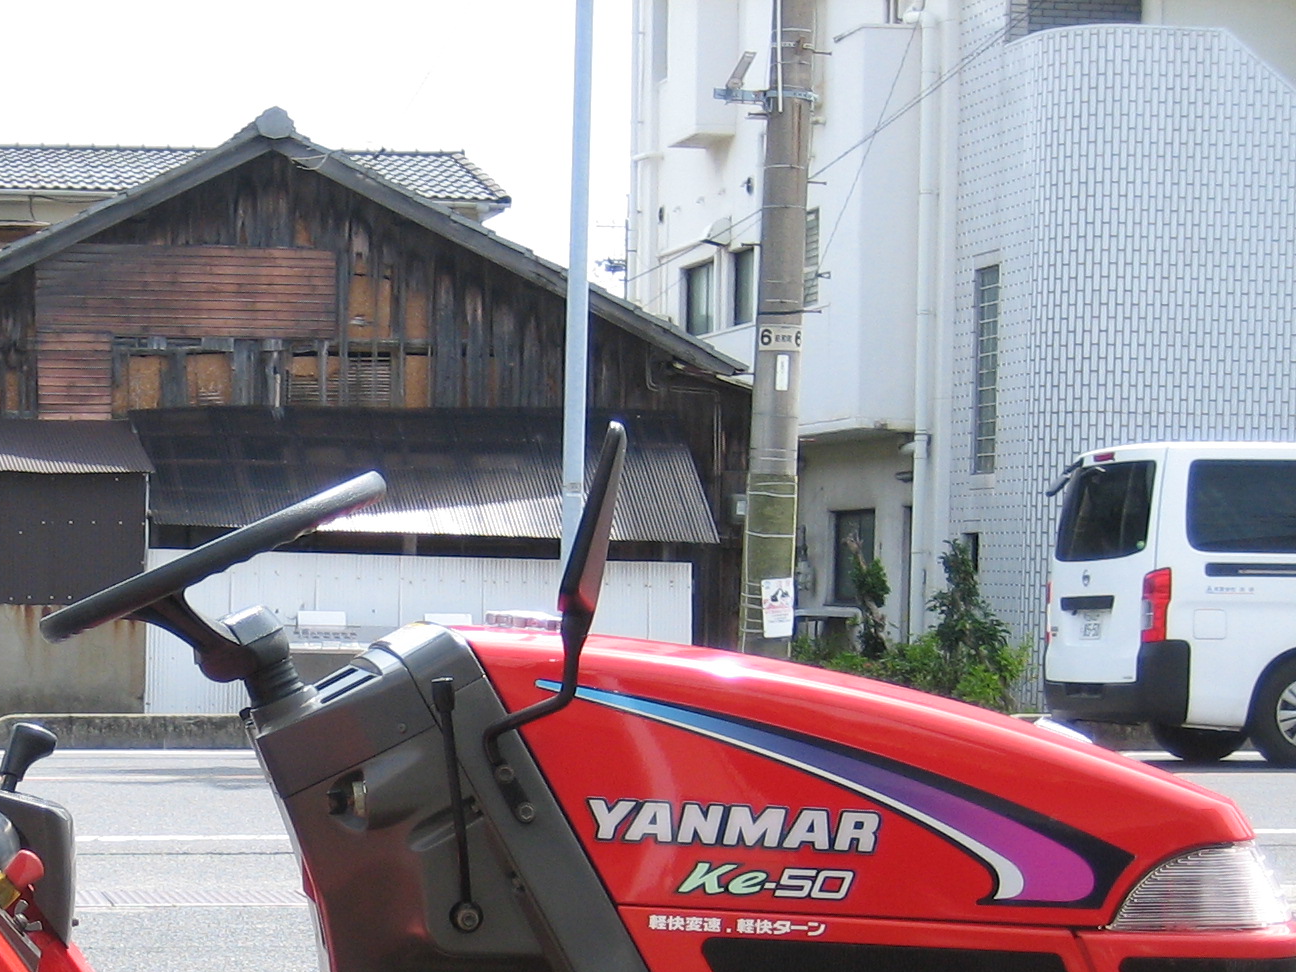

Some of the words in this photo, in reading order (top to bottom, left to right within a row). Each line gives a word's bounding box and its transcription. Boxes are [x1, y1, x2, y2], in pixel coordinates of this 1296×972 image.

[761, 329, 772, 346] 6
[588, 798, 880, 852] YANMAR
[677, 862, 855, 900] Ke-50
